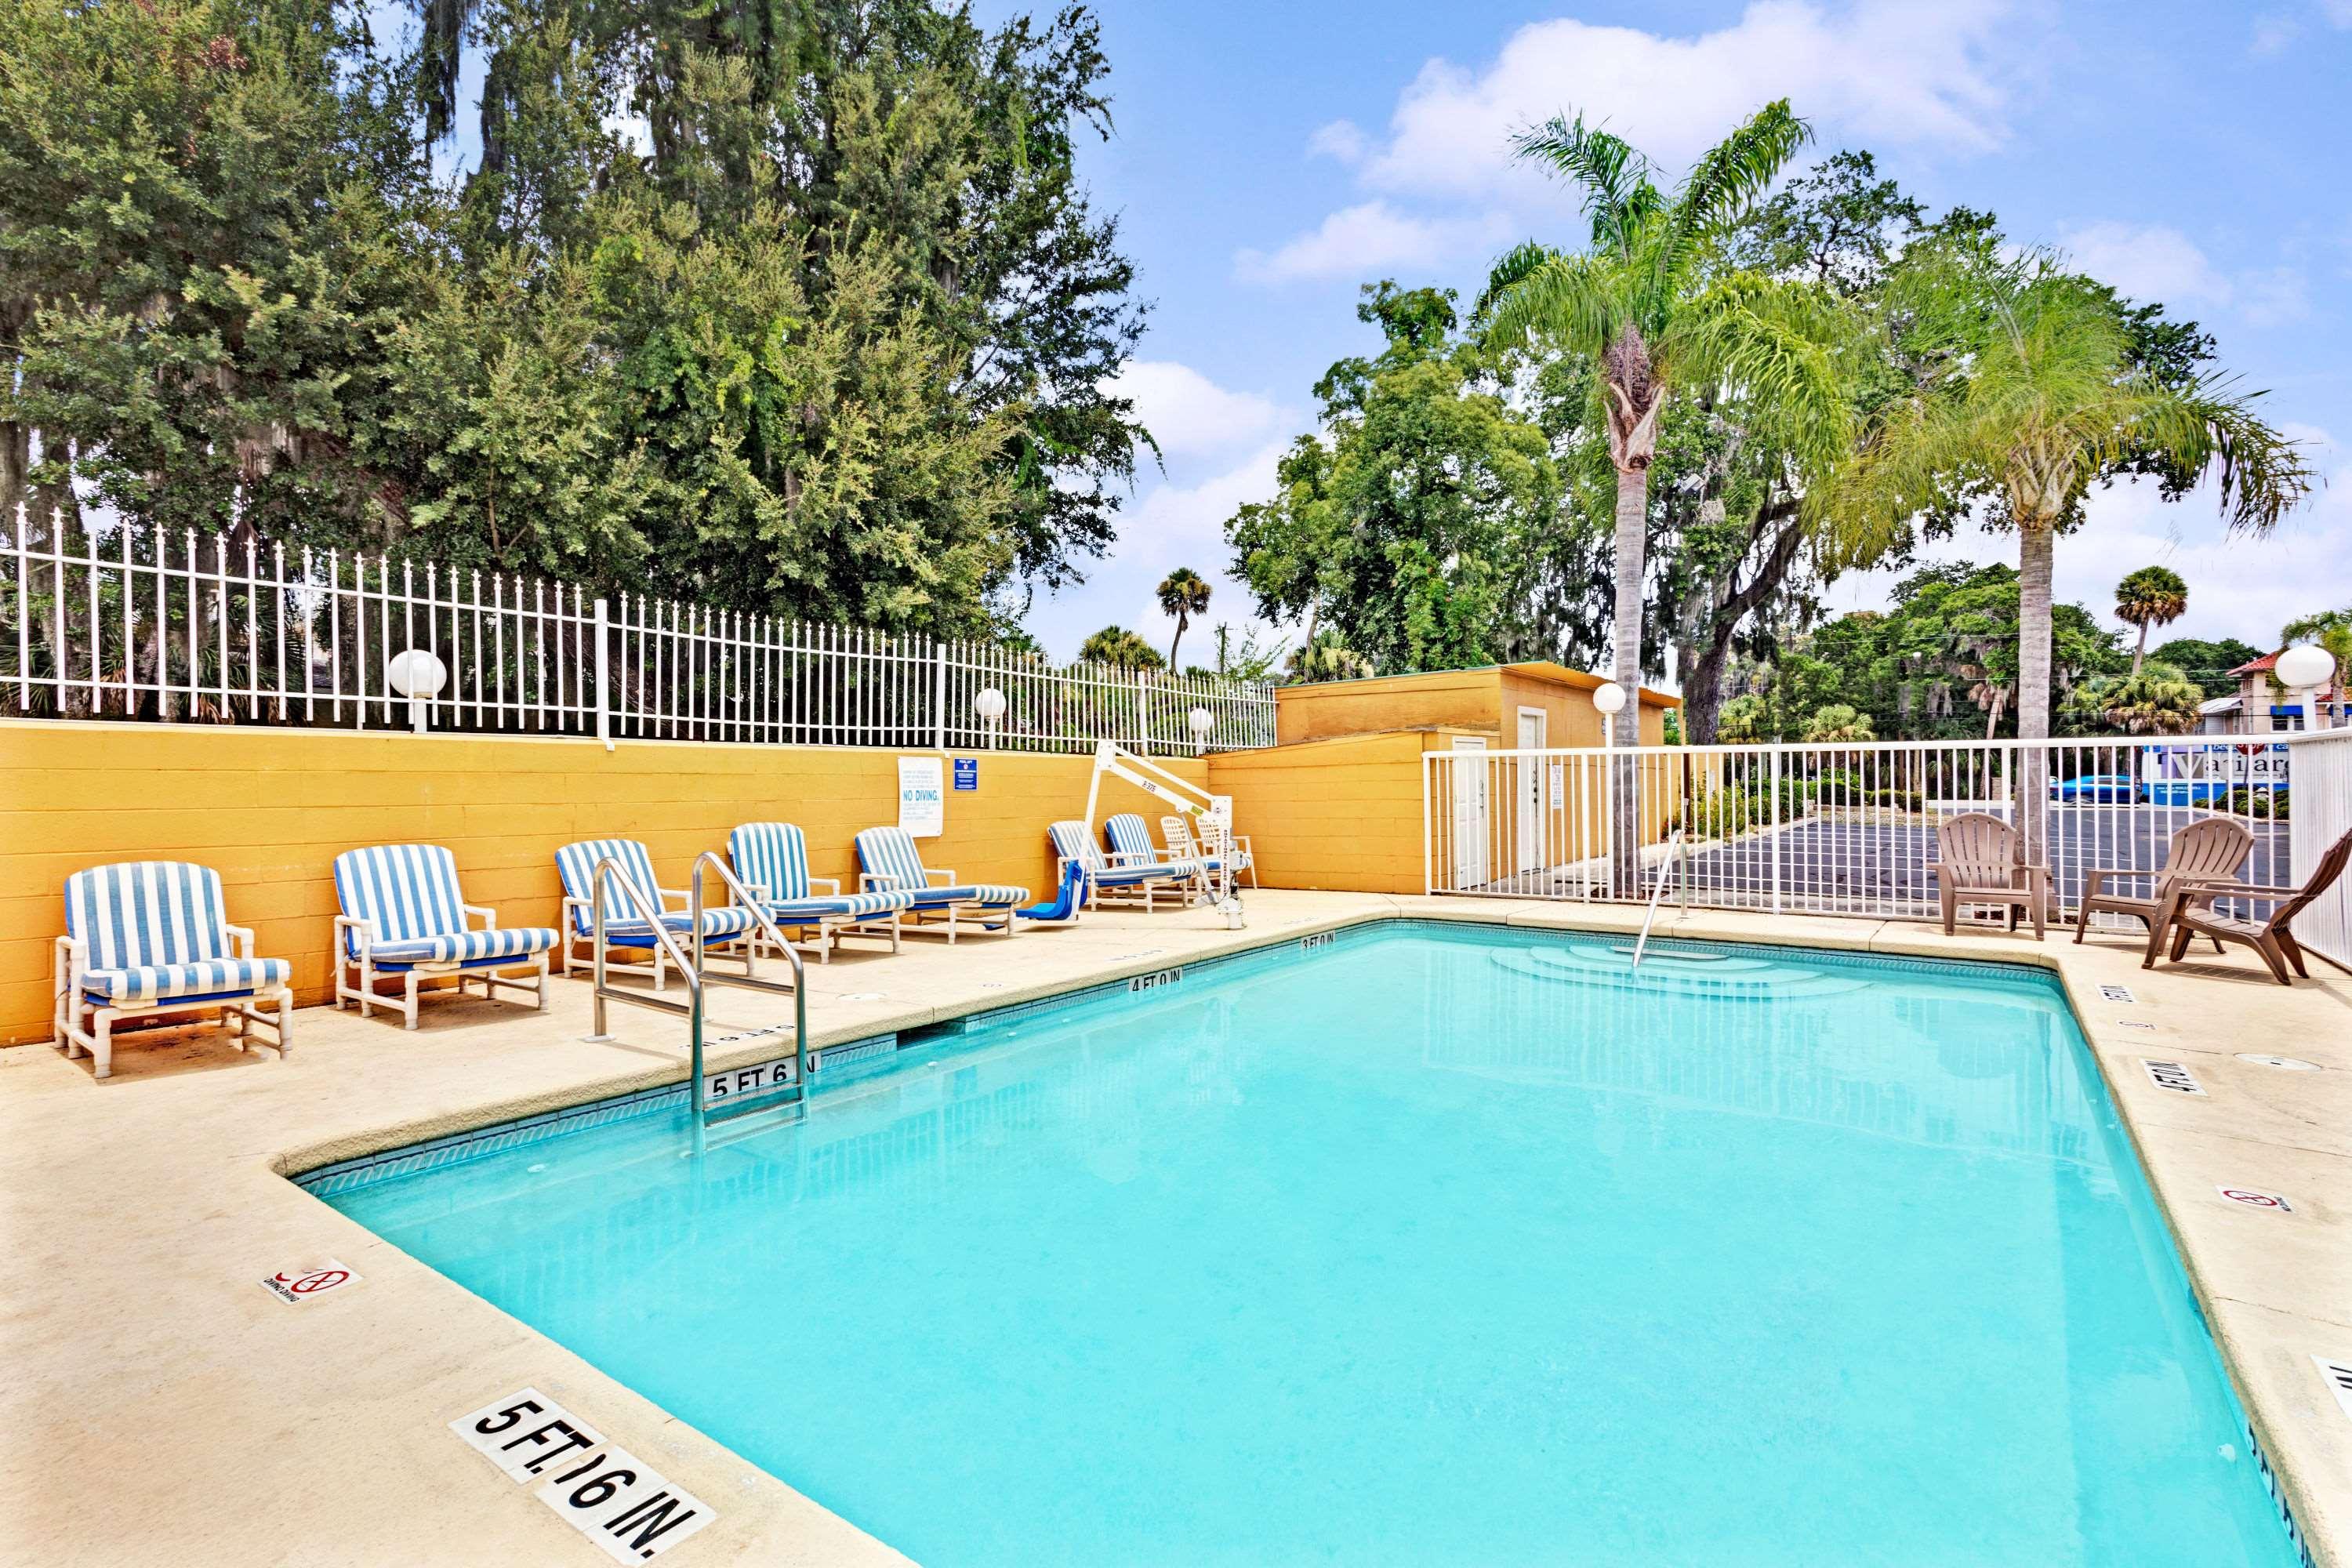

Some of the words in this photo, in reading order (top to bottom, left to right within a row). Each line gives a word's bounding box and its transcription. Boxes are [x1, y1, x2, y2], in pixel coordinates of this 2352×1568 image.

[903, 789, 913, 801] NO
[1310, 936, 1318, 947] FT
[1143, 975, 1156, 989] FT
[1171, 969, 1180, 982] IN
[713, 1077, 728, 1098] 5
[773, 1064, 787, 1082] 6
[475, 1399, 545, 1434] 5
[603, 1490, 697, 1559] IN.
